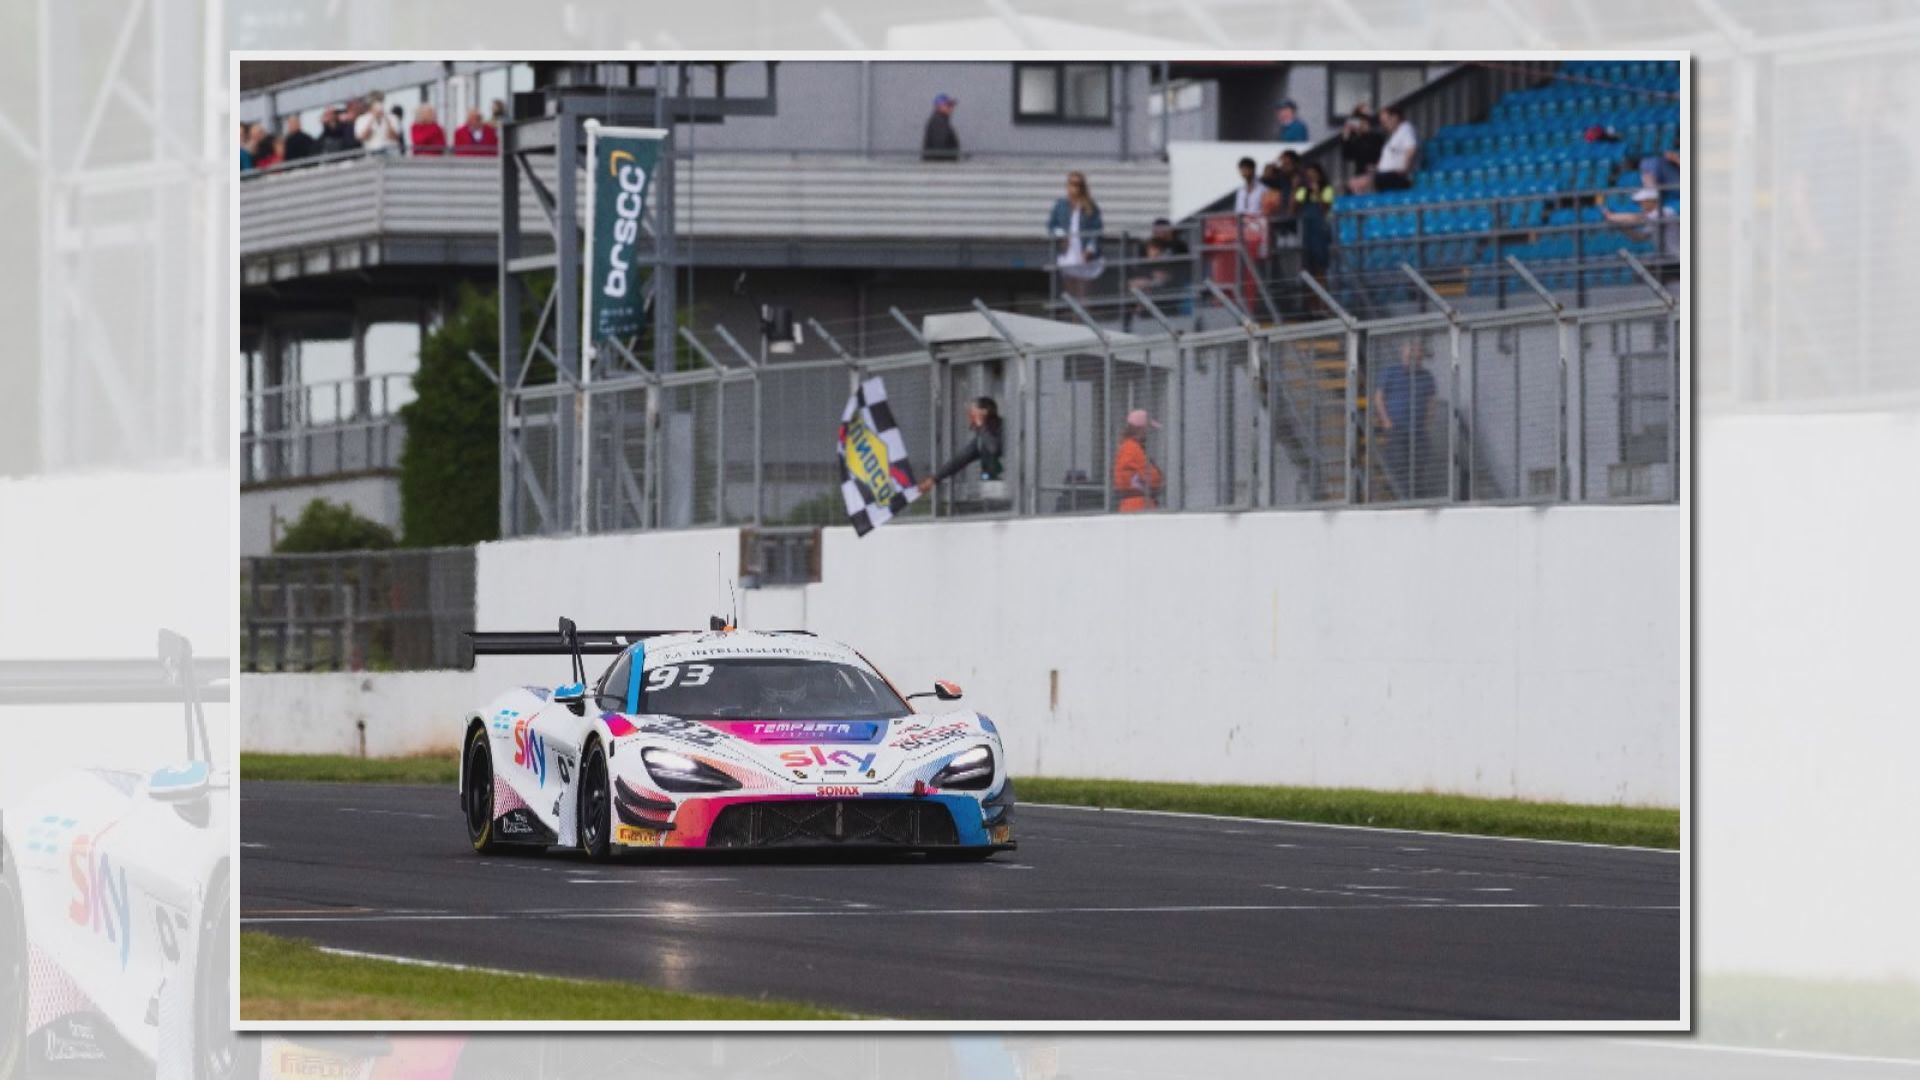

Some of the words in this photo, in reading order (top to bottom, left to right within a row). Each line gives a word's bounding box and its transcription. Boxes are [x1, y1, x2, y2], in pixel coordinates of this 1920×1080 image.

[603, 164, 645, 297] brscc
[645, 663, 715, 692] 93
[779, 745, 876, 773] sky
[816, 786, 860, 796] SONAX
